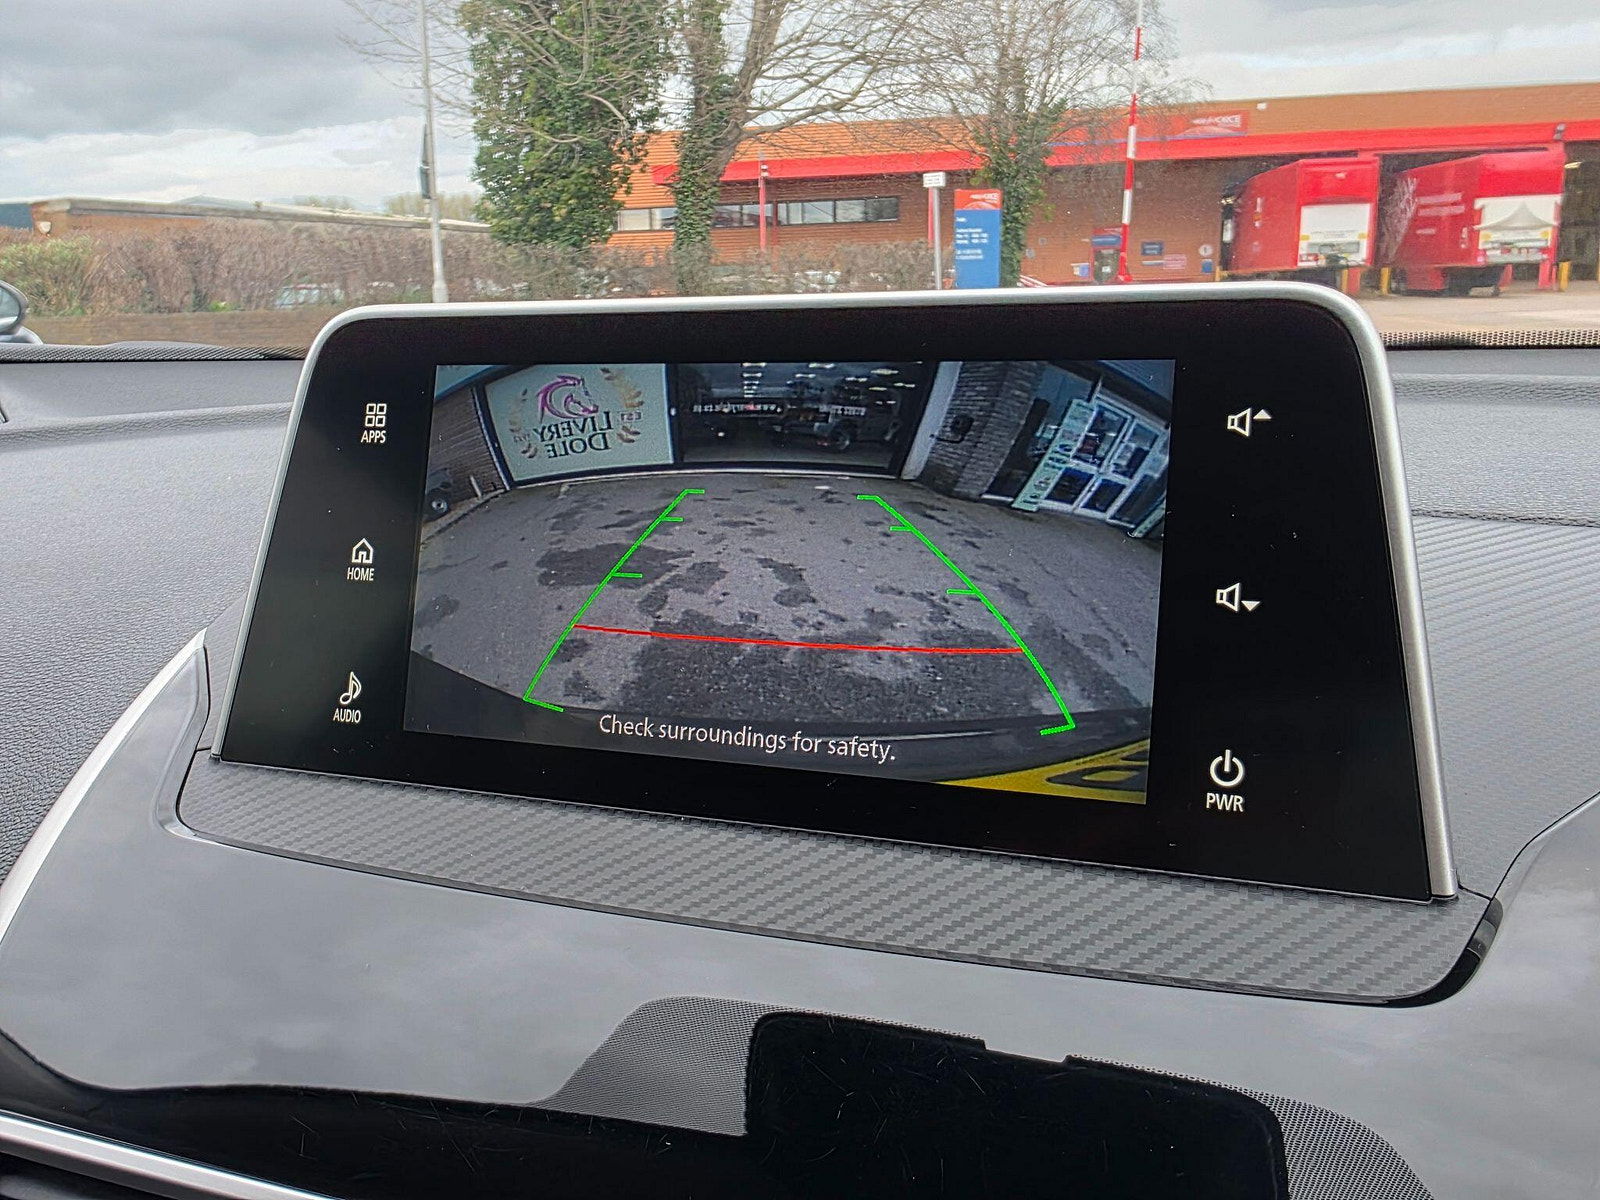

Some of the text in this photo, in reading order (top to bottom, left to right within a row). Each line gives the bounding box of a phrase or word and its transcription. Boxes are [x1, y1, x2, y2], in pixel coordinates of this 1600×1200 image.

[360, 430, 387, 443] APPS
[346, 567, 375, 581] HOME
[332, 707, 361, 723] AUDIO
[599, 714, 896, 765] Check surroundings for safety.
[1205, 792, 1244, 812] PWR
